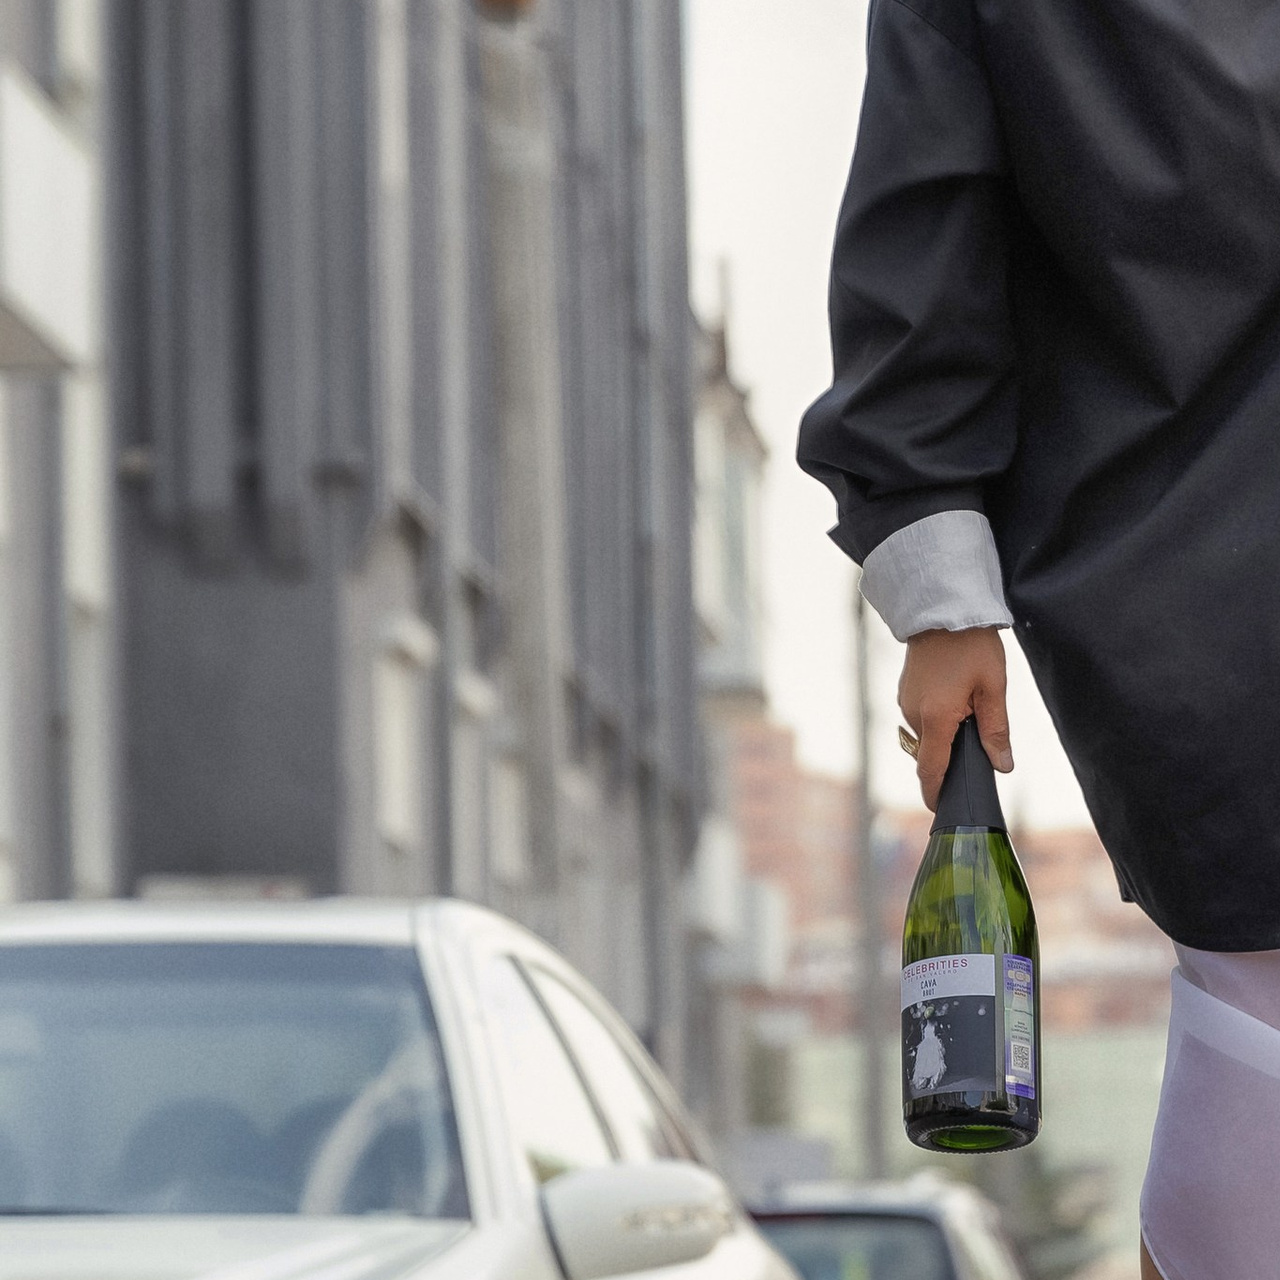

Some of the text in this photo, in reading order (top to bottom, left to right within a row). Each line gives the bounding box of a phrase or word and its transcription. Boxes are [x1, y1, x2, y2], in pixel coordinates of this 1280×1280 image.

[903, 958, 968, 981] CELEBRITIES
[920, 978, 937, 989] CAVA
[922, 988, 935, 997] BRUT
